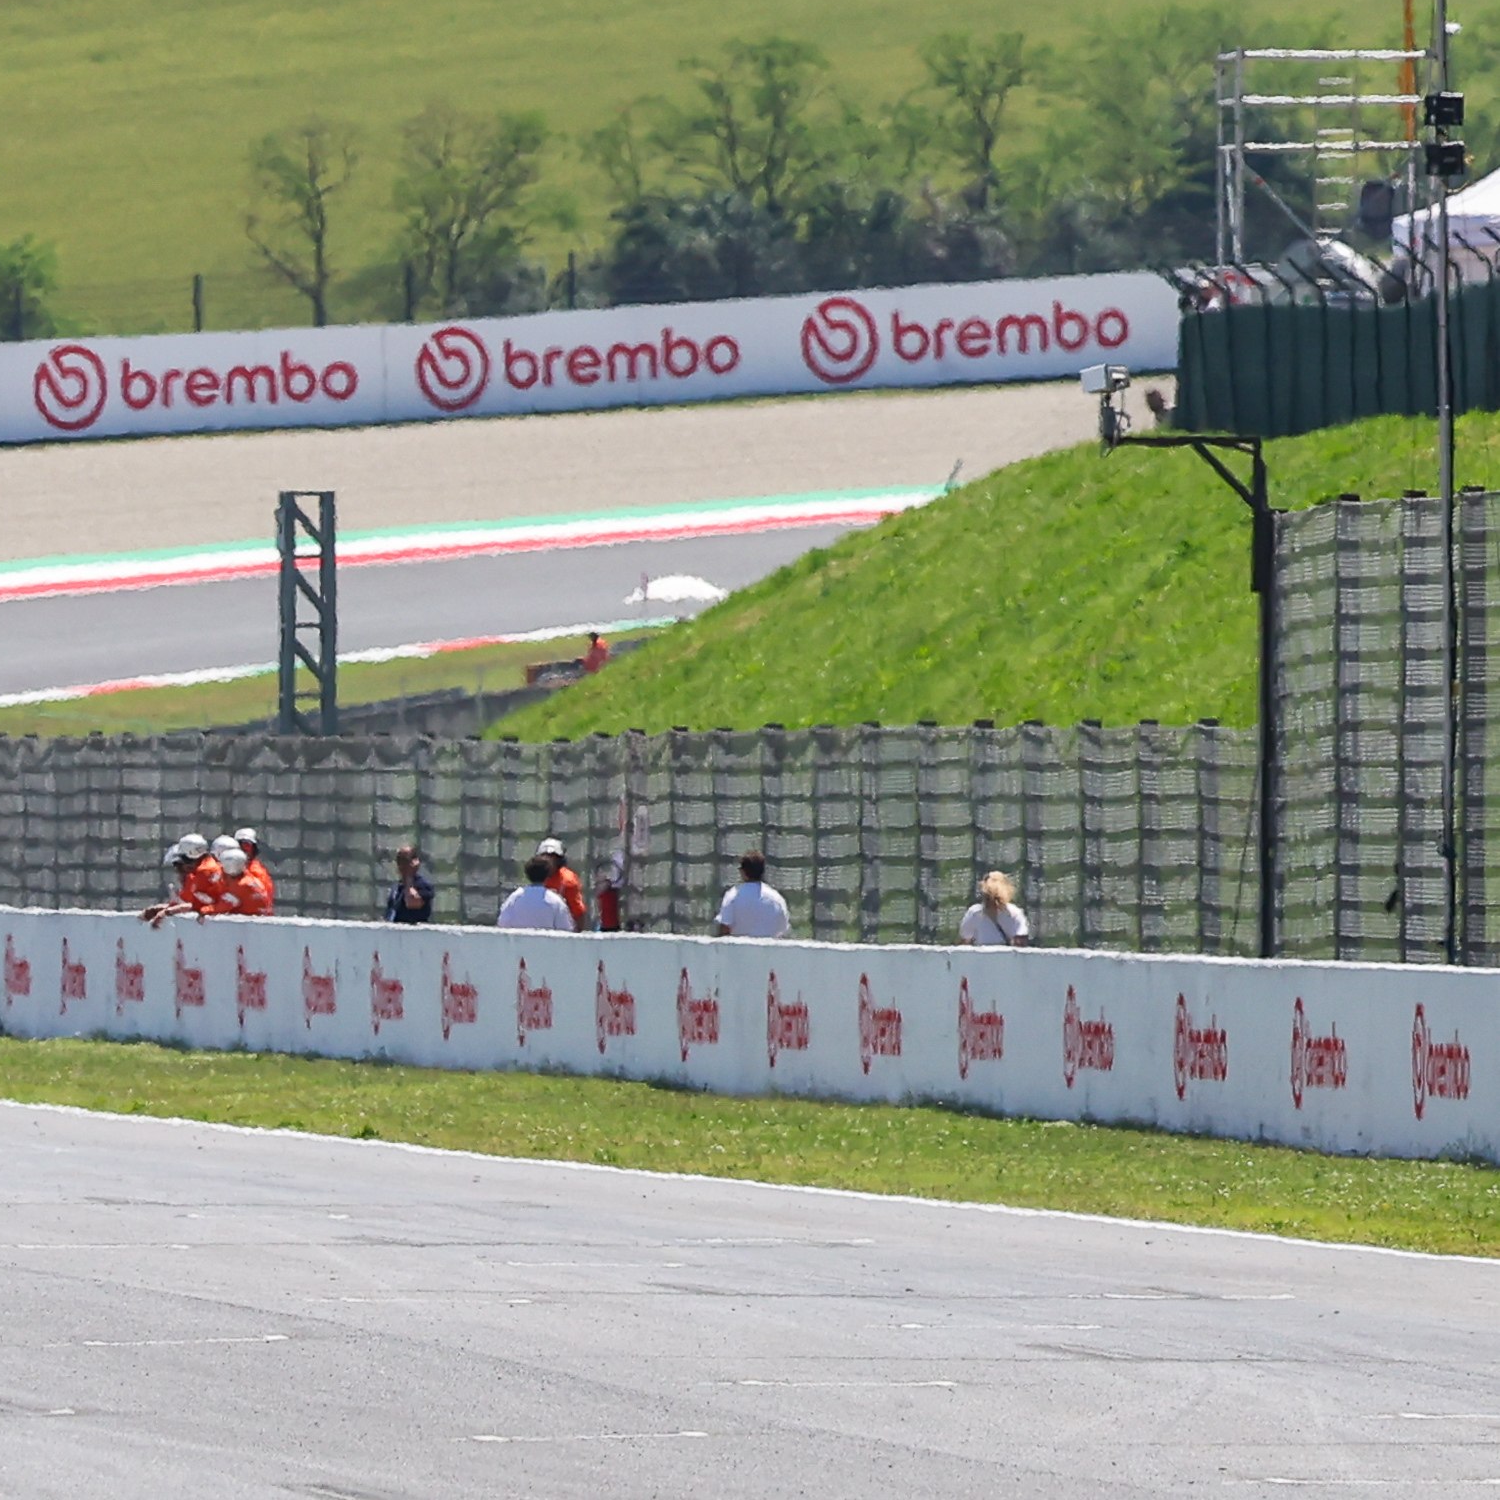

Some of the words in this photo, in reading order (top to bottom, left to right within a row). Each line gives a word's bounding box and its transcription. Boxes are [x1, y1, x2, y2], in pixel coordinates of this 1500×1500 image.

[503, 328, 740, 389] brembo
[891, 302, 1129, 362] brembo
[120, 351, 358, 409] brembo
